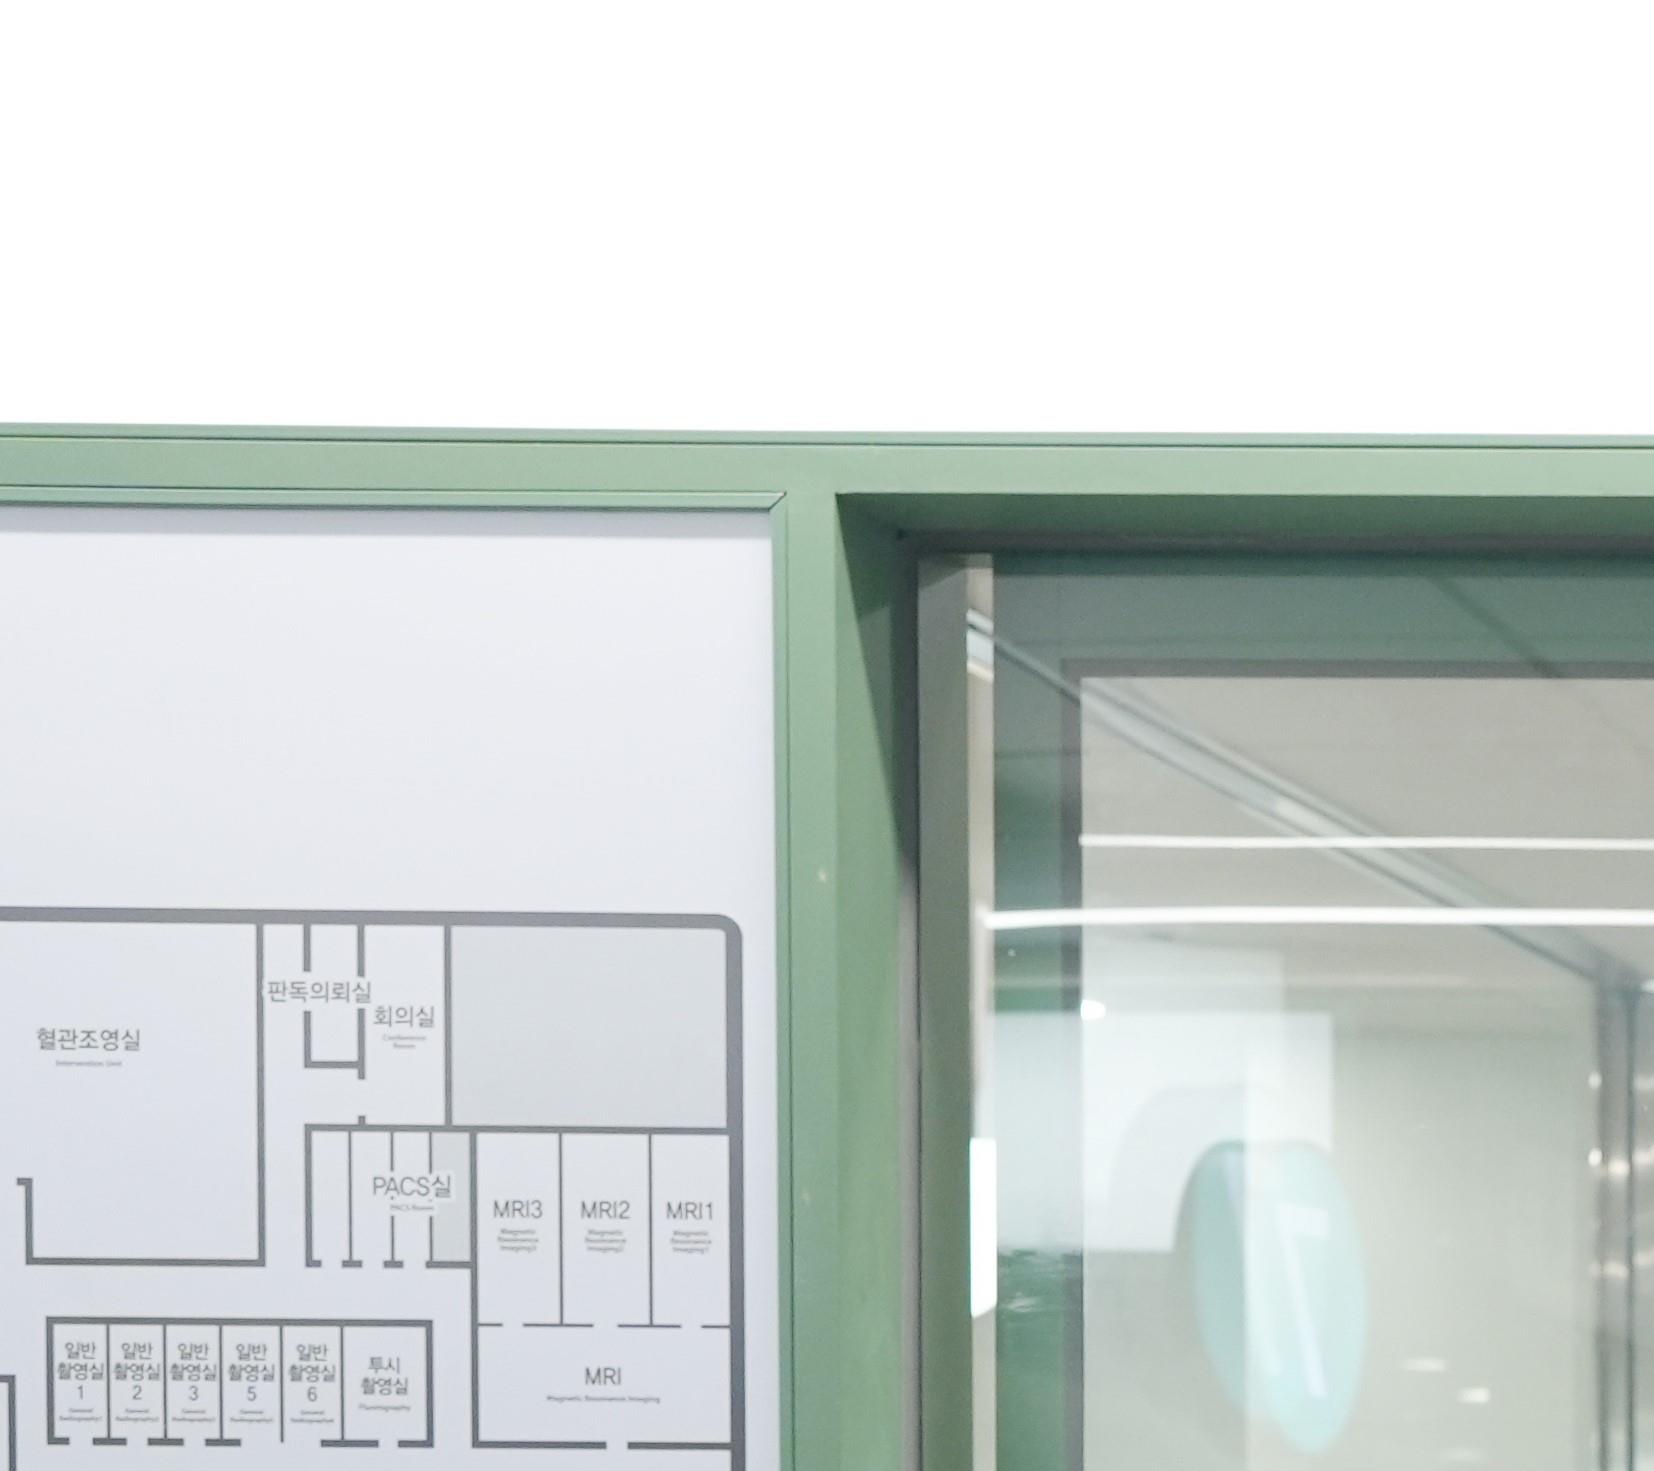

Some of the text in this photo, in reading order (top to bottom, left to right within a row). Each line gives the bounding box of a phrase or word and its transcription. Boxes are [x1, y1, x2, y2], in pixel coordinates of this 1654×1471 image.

[266, 978, 374, 1005] 판독의뢰실
[374, 1006, 434, 1028] 회의실
[38, 1028, 139, 1051] 혈관조영실
[372, 1174, 452, 1200] PACS실
[494, 1200, 542, 1219] MRI3
[581, 1201, 630, 1219] MRI2
[667, 1202, 712, 1219] MRI1
[65, 1342, 95, 1359] 일반
[122, 1343, 152, 1360] 일반
[178, 1343, 208, 1360] 일반
[236, 1344, 267, 1361] 일반
[296, 1344, 328, 1361] 일반
[56, 1362, 105, 1382] 촬영실
[112, 1362, 163, 1382] 촬영실
[168, 1363, 219, 1383] 촬영실
[368, 1357, 400, 1373] 투시
[226, 1364, 277, 1384] 촬영실
[286, 1364, 338, 1384] 촬영실
[586, 1368, 621, 1384] MRI
[78, 1385, 83, 1399] 1
[133, 1385, 142, 1400] 2
[189, 1385, 198, 1401] 3
[248, 1386, 256, 1401] 5
[307, 1386, 317, 1402] 6
[362, 1378, 407, 1395] 촬영실
